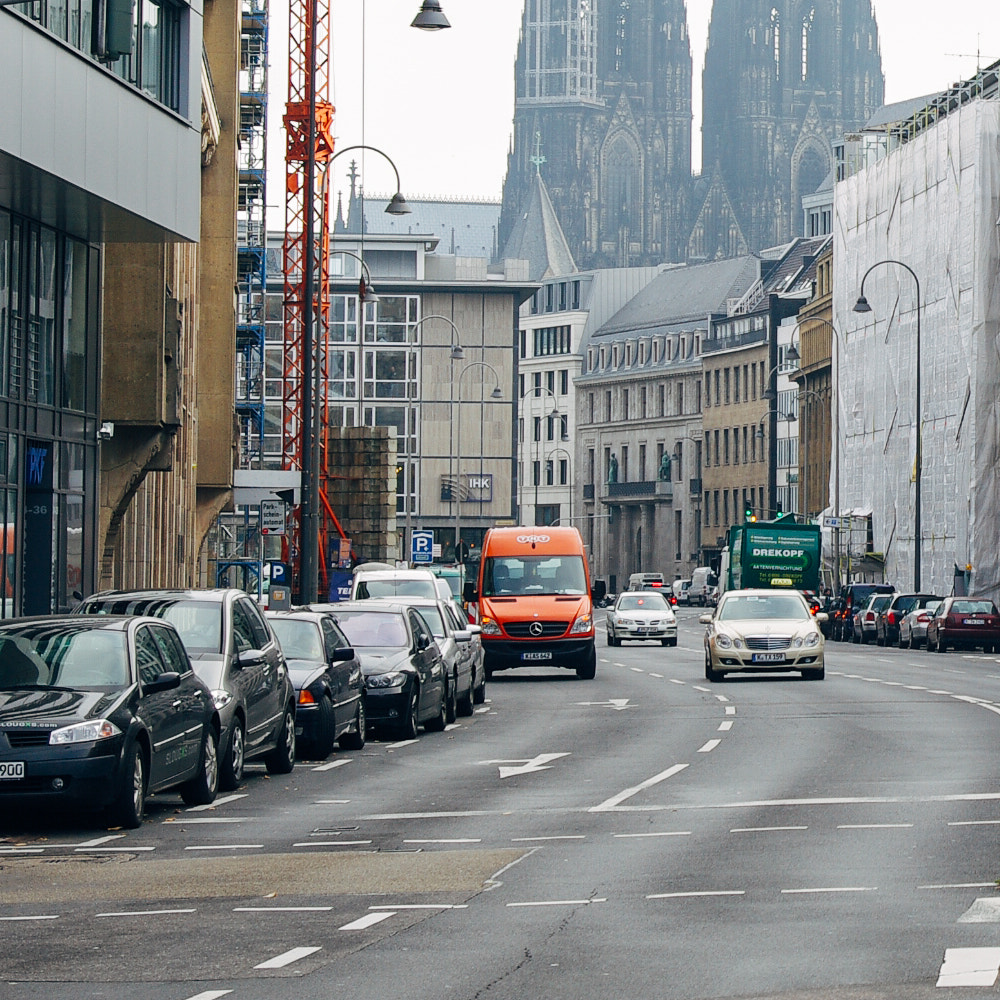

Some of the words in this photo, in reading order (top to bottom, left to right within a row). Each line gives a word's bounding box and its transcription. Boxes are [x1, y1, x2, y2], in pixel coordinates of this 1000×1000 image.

[469, 478, 490, 489] IHK
[417, 538, 428, 551] P
[753, 549, 804, 557] DREKOPF
[273, 565, 284, 578] P
[0, 763, 24, 777] 900
